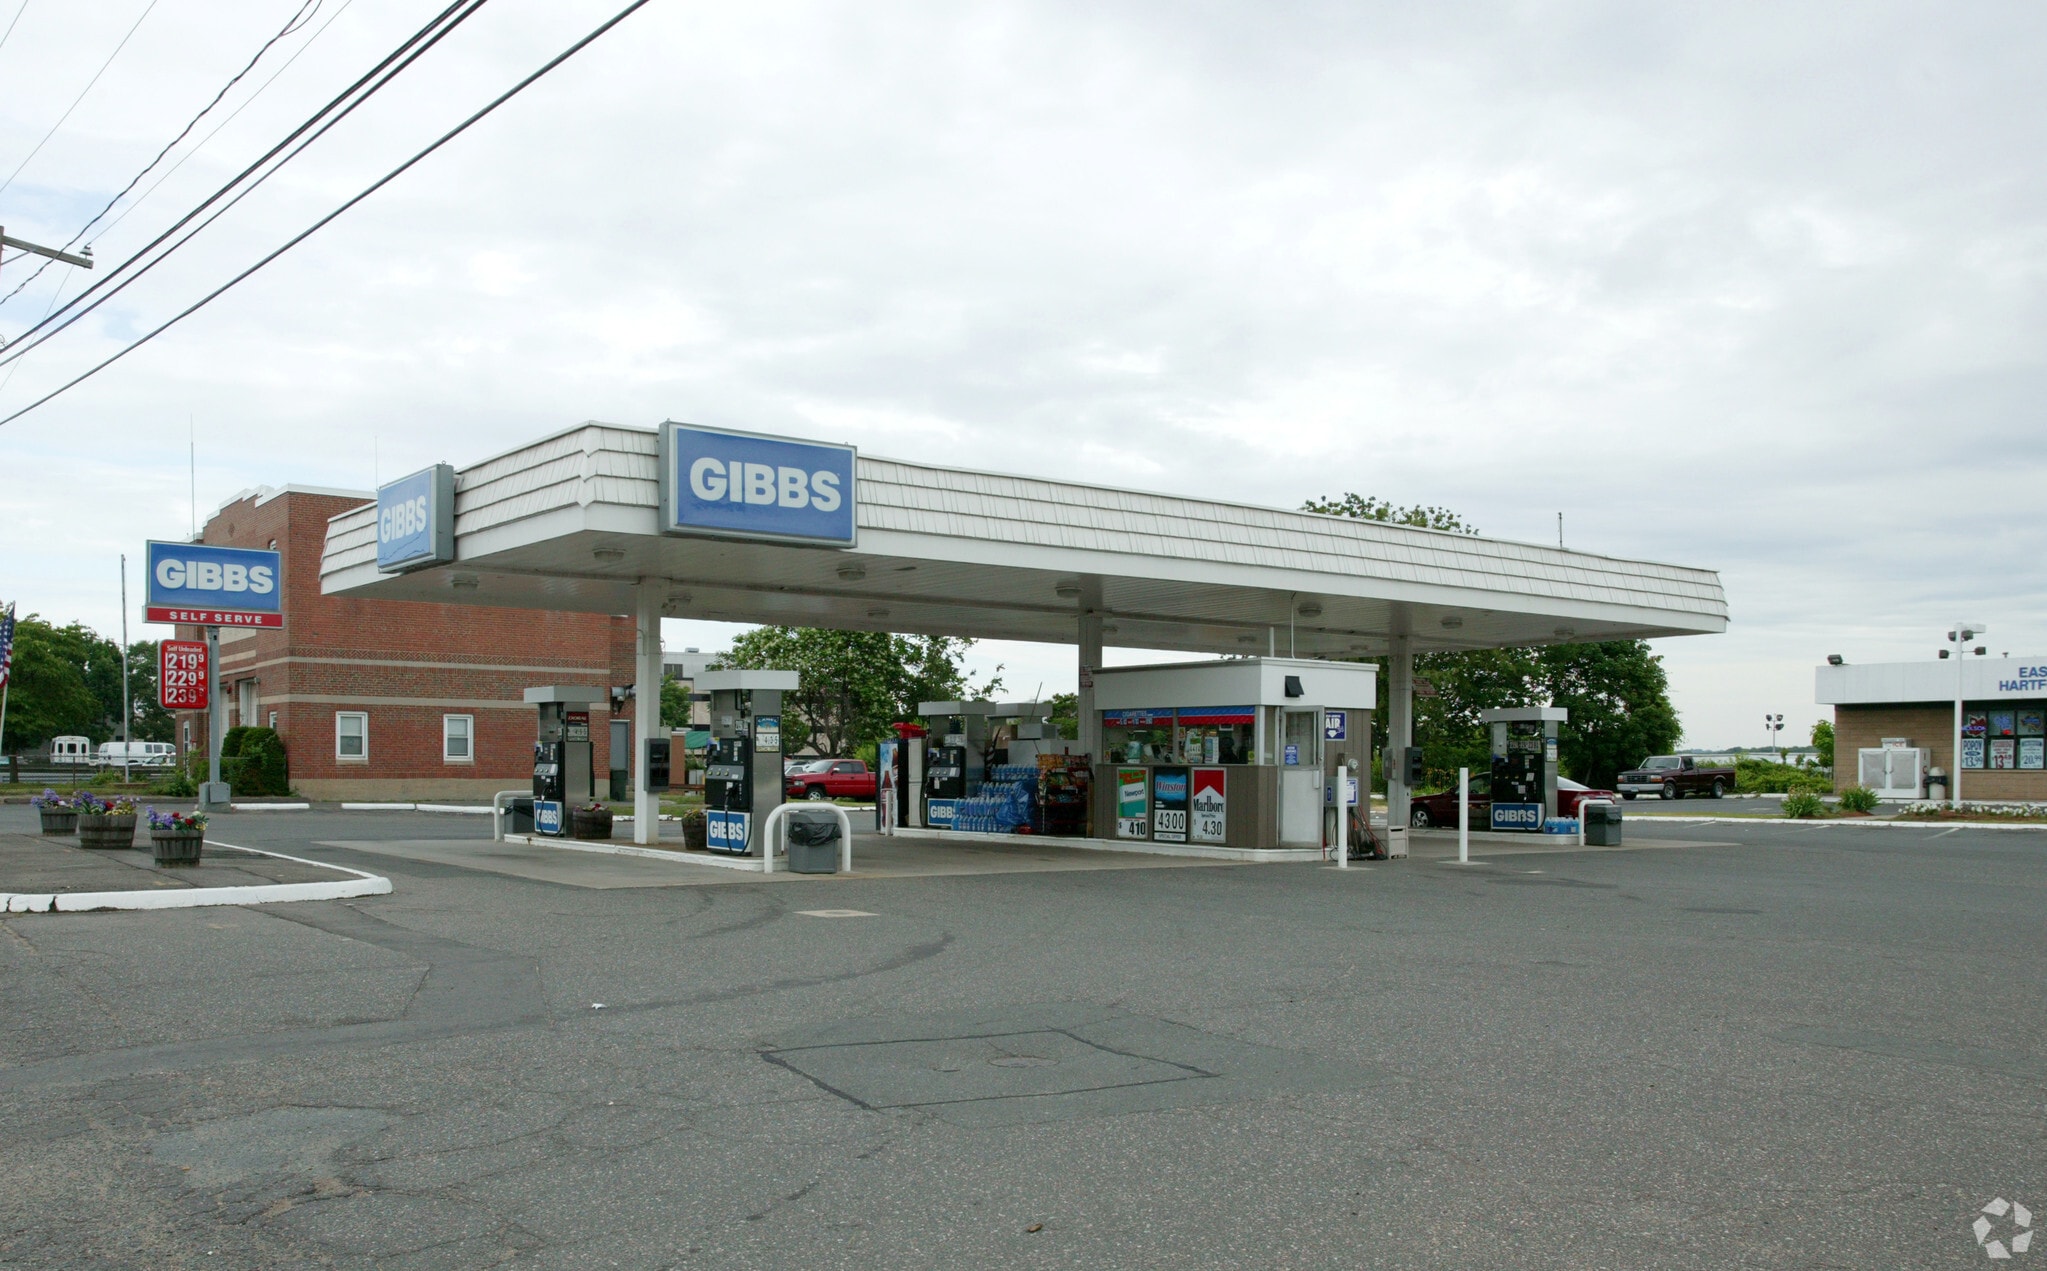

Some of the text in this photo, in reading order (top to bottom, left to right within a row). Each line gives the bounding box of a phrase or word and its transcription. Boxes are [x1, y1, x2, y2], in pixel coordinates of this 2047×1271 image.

[689, 456, 842, 512] GIBBS
[379, 494, 427, 544] GIBBS
[156, 558, 273, 594] GIBBS
[169, 611, 263, 625] SELF SERVE
[178, 645, 203, 653] Unleaded
[1325, 717, 1341, 729] AIR
[1156, 781, 1187, 793] Winston
[930, 805, 955, 819] GIBB
[1494, 809, 1537, 824] GIBBS
[1129, 821, 1146, 836] 410
[1202, 820, 1223, 836] 4.30
